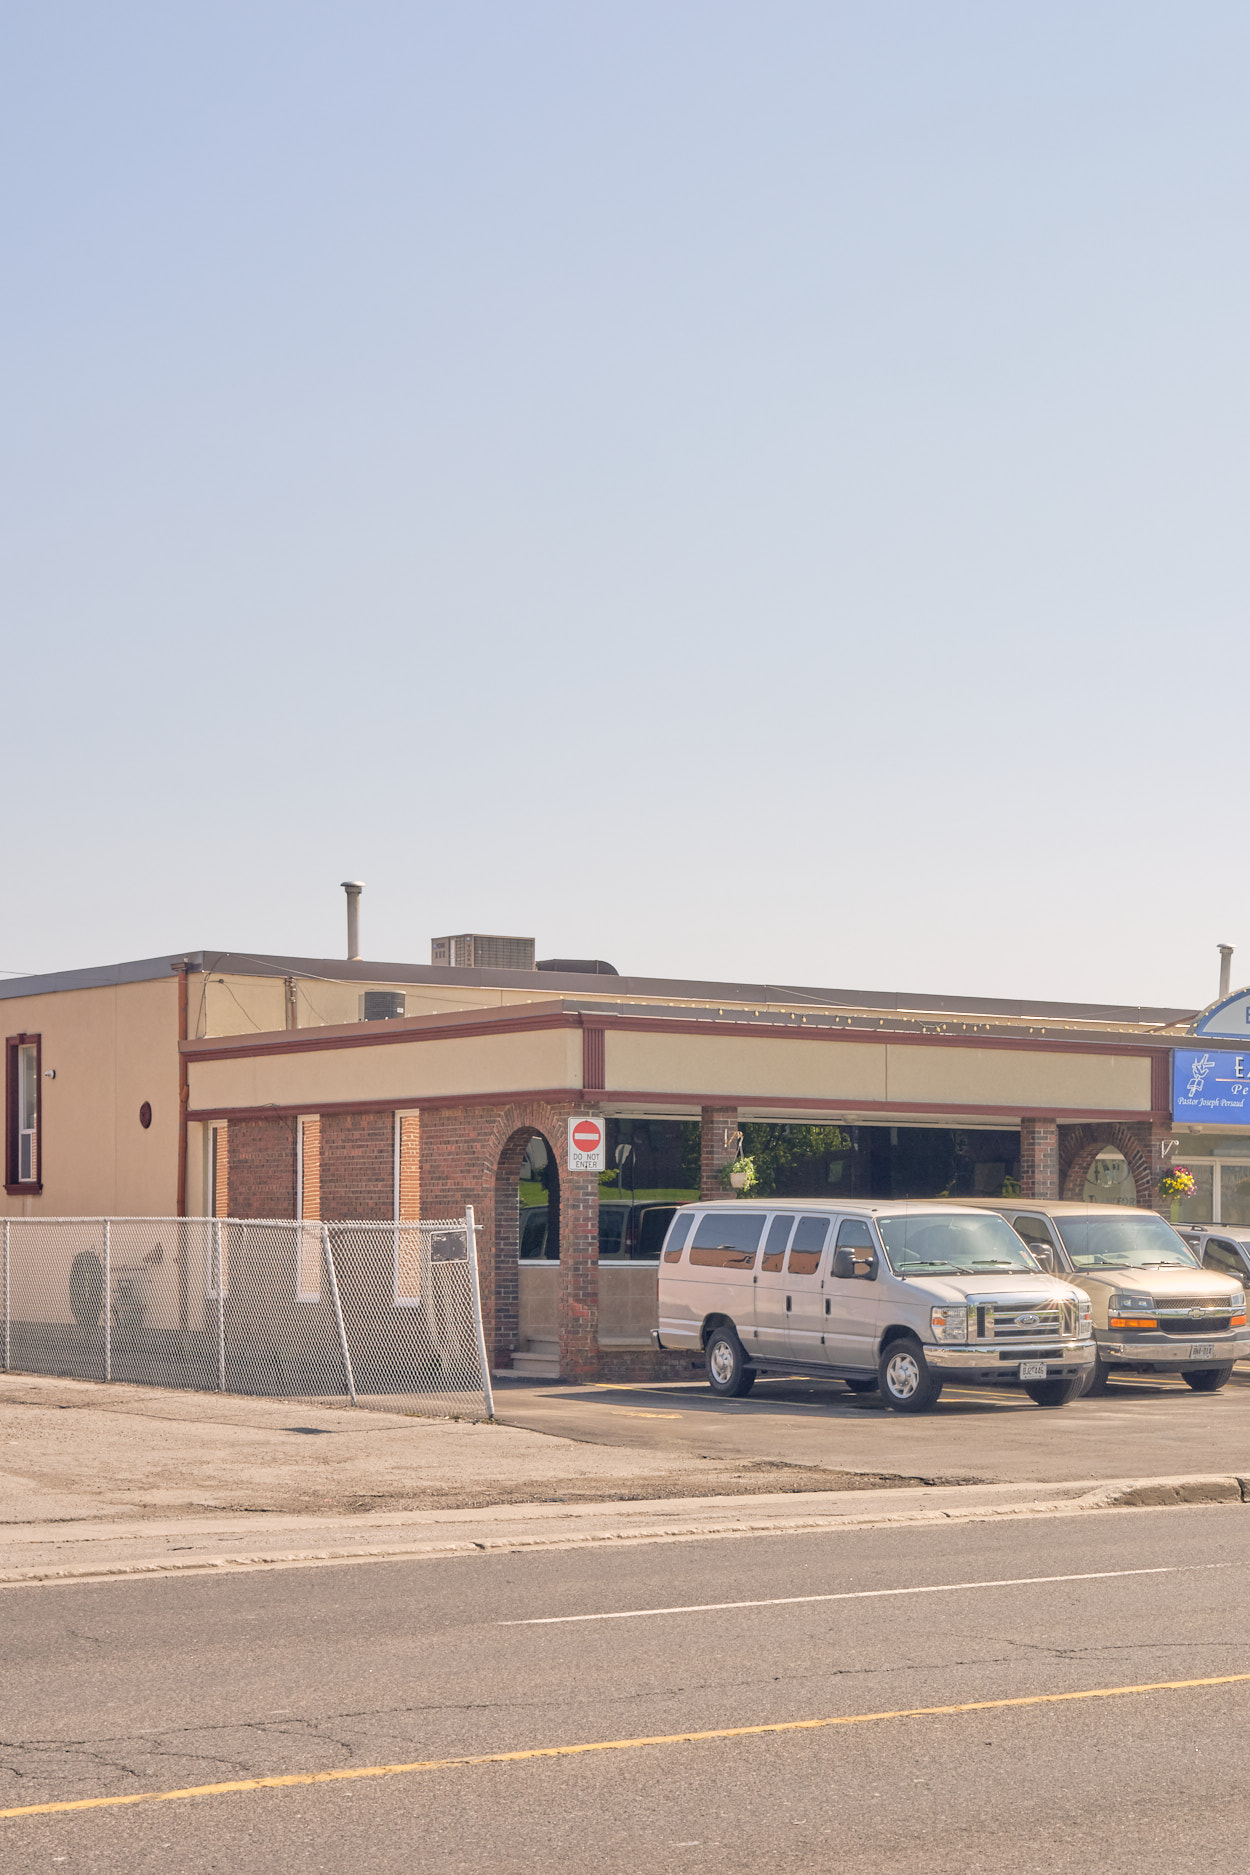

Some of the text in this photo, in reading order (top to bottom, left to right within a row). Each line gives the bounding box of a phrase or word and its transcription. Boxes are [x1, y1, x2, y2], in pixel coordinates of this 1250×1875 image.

[1177, 1097, 1246, 1108] Pastor Joseph Persaud
[573, 1153, 600, 1161] DO NOT
[575, 1160, 598, 1169] ENTER
